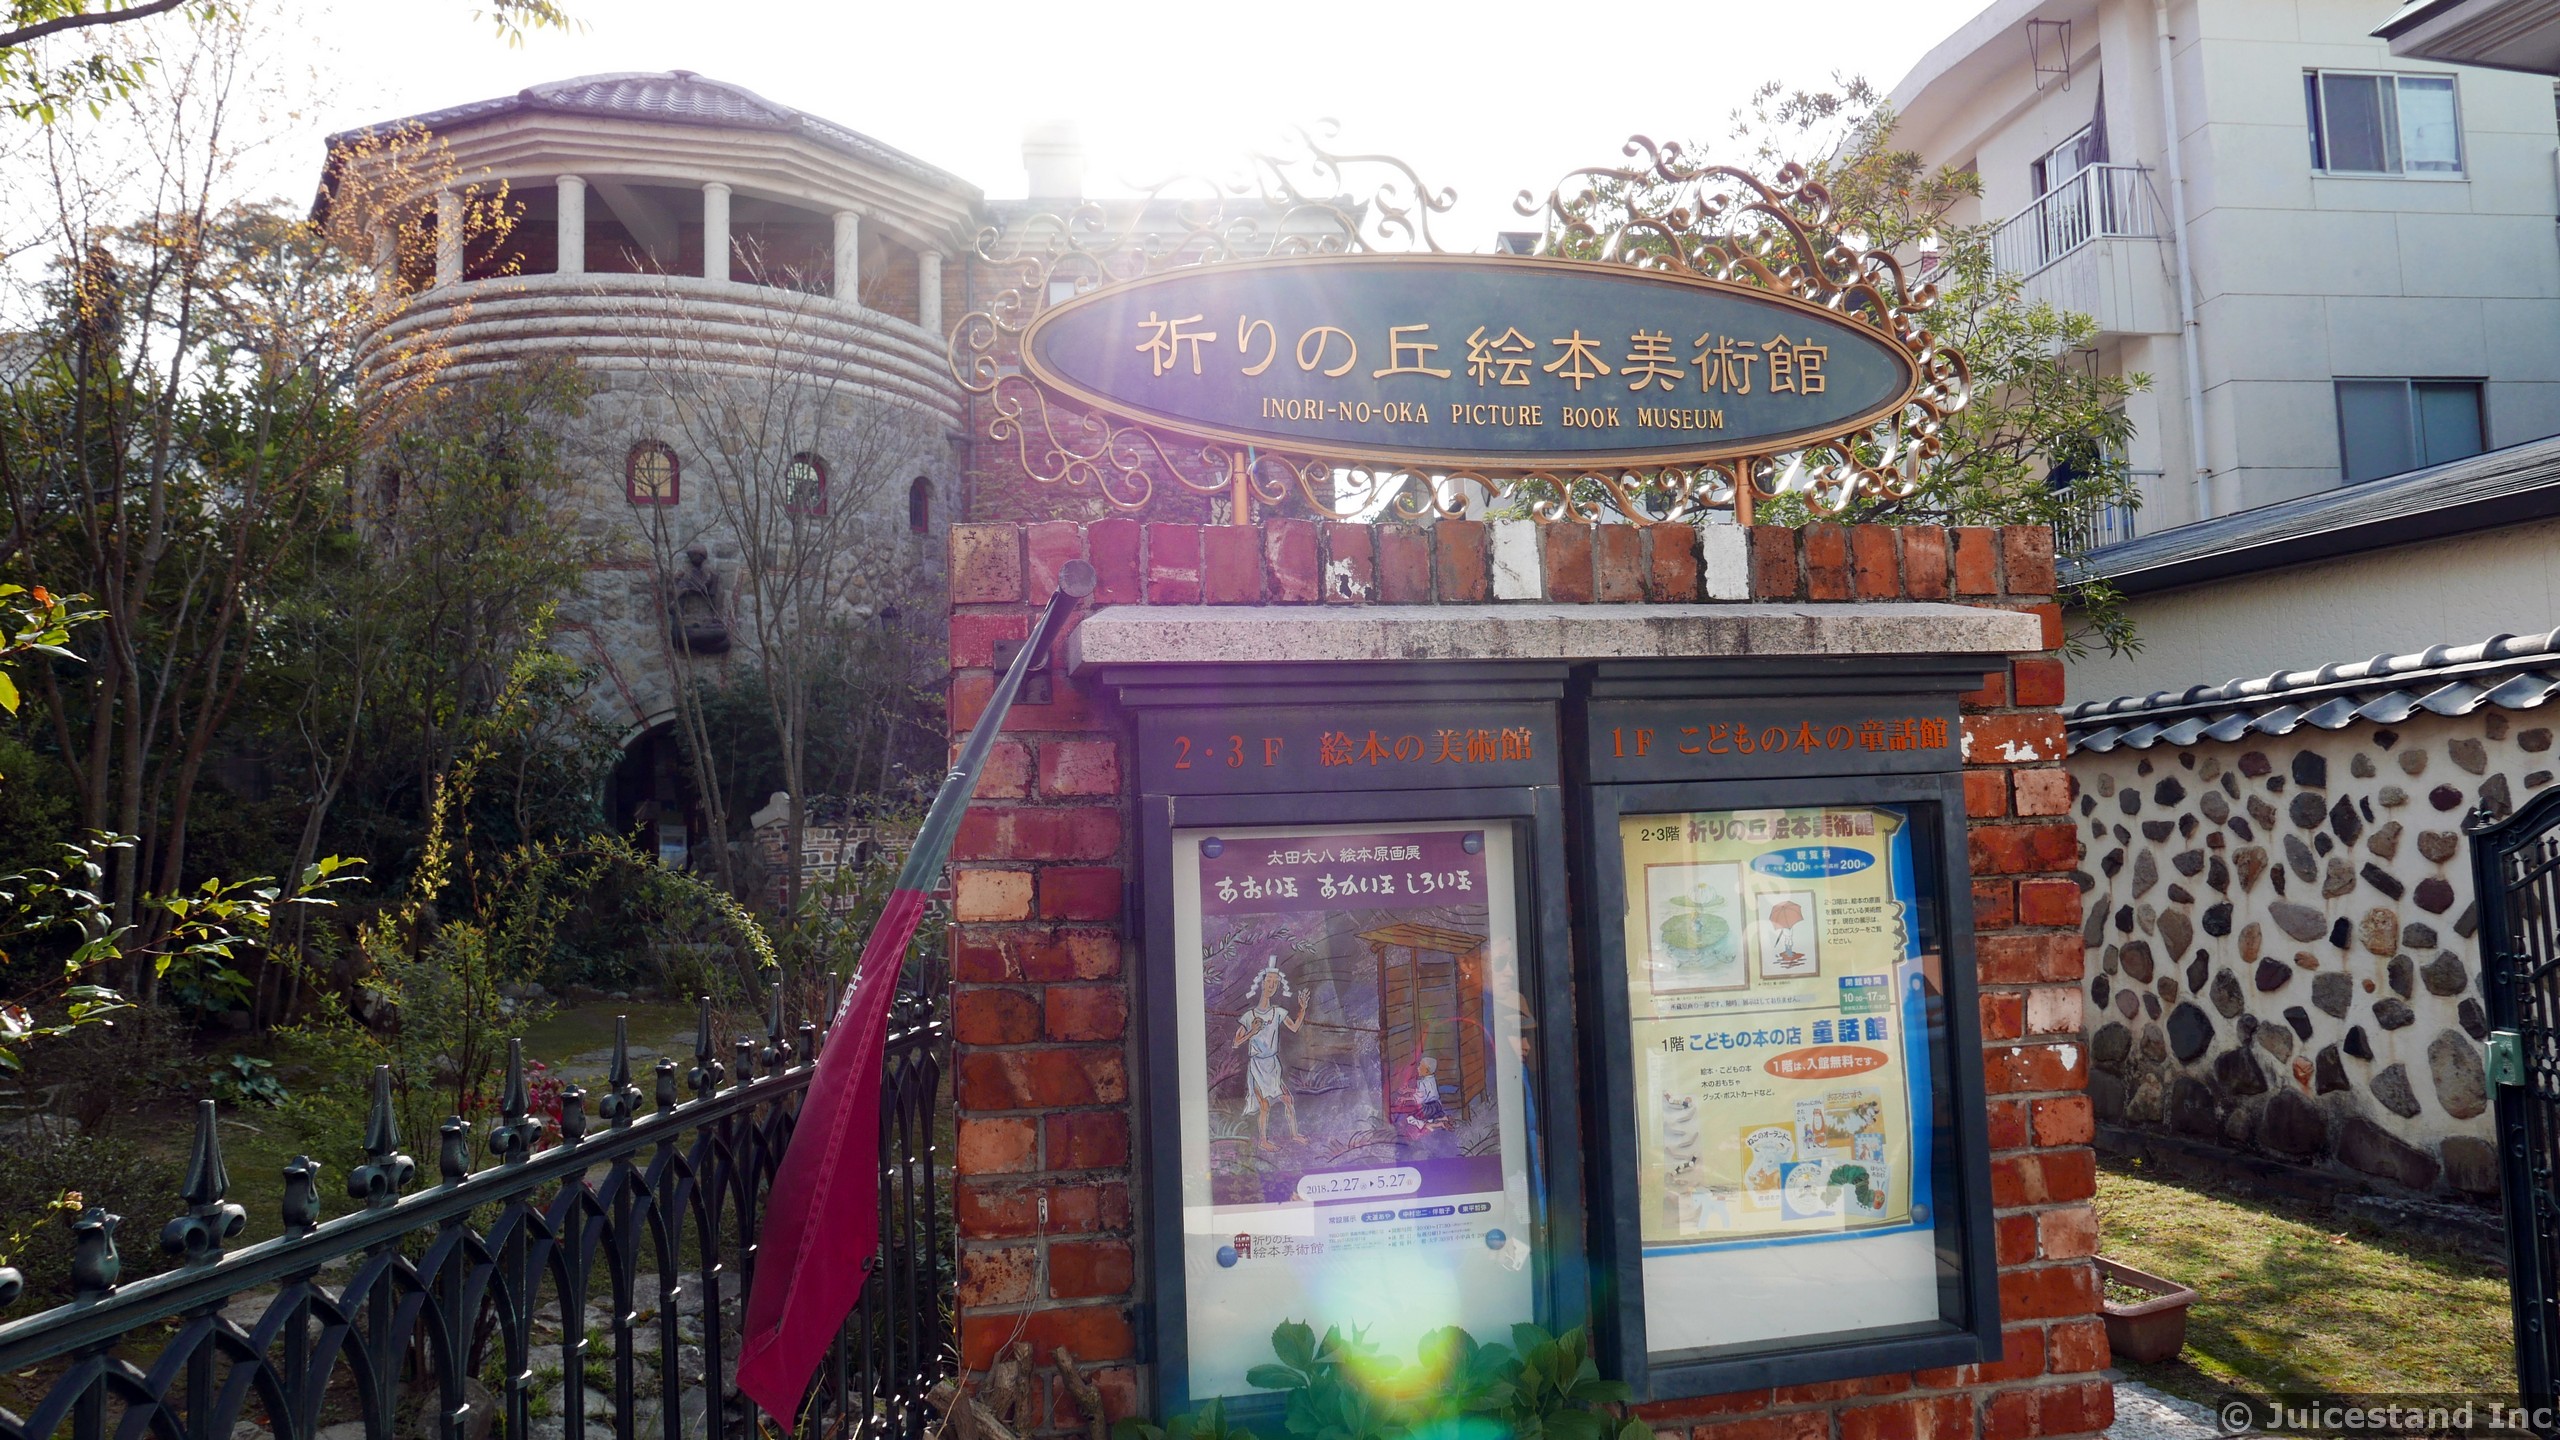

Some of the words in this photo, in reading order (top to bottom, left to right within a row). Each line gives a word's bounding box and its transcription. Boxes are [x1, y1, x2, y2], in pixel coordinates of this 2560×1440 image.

[1135, 311, 1829, 396] 祈りの丘絵本美術館
[1261, 397, 1431, 427] INORI-NO-OKA
[1451, 403, 1544, 428] PICTURE
[1562, 405, 1620, 429] BOOK
[1637, 408, 1725, 432] MUSEUM
[1319, 727, 1533, 768] 絵本の美術館
[1678, 717, 1950, 756] こどもの本の童話館
[1687, 813, 1875, 844] 祈りの丘絵本美術館
[1267, 849, 1335, 866] 太田大八
[1340, 845, 1421, 864] 絵本原画展
[1317, 873, 1395, 899] あかい玉
[1407, 870, 1473, 894] しろい玉
[1690, 1026, 1802, 1051] こどもの本の店
[1812, 1016, 1888, 1045] 童話館
[1253, 1234, 1294, 1246] 祈りの丘
[1253, 1243, 1324, 1259] 絵本美術館
